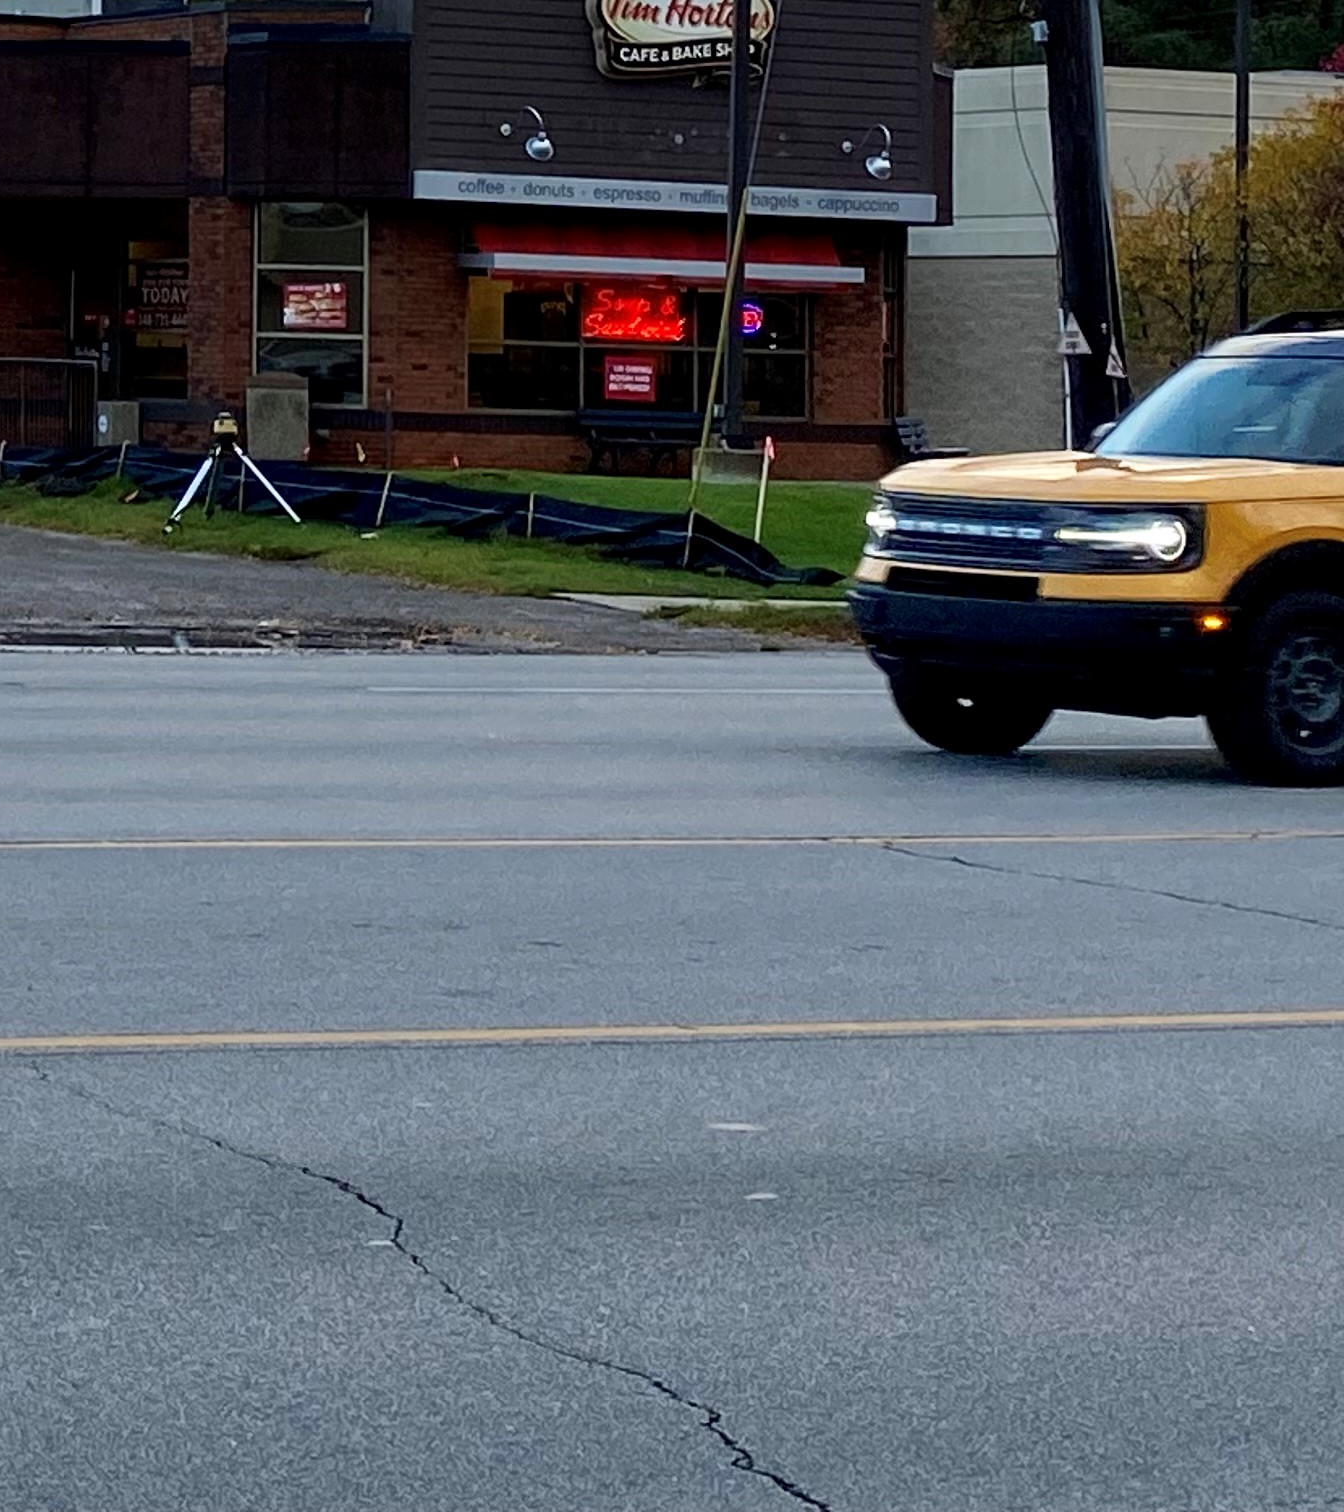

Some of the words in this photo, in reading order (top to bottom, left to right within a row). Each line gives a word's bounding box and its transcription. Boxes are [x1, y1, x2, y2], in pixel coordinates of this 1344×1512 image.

[619, 47, 659, 62] CAFE
[660, 51, 670, 61] &
[671, 44, 712, 60] BAKE
[715, 43, 755, 57] SHP
[457, 178, 505, 195] coffee
[522, 181, 575, 199] donuts
[593, 185, 662, 203] espresso
[679, 190, 730, 205] muffin
[750, 193, 800, 211] bagels
[817, 196, 900, 213] cappuccino
[141, 286, 190, 305] TODAY
